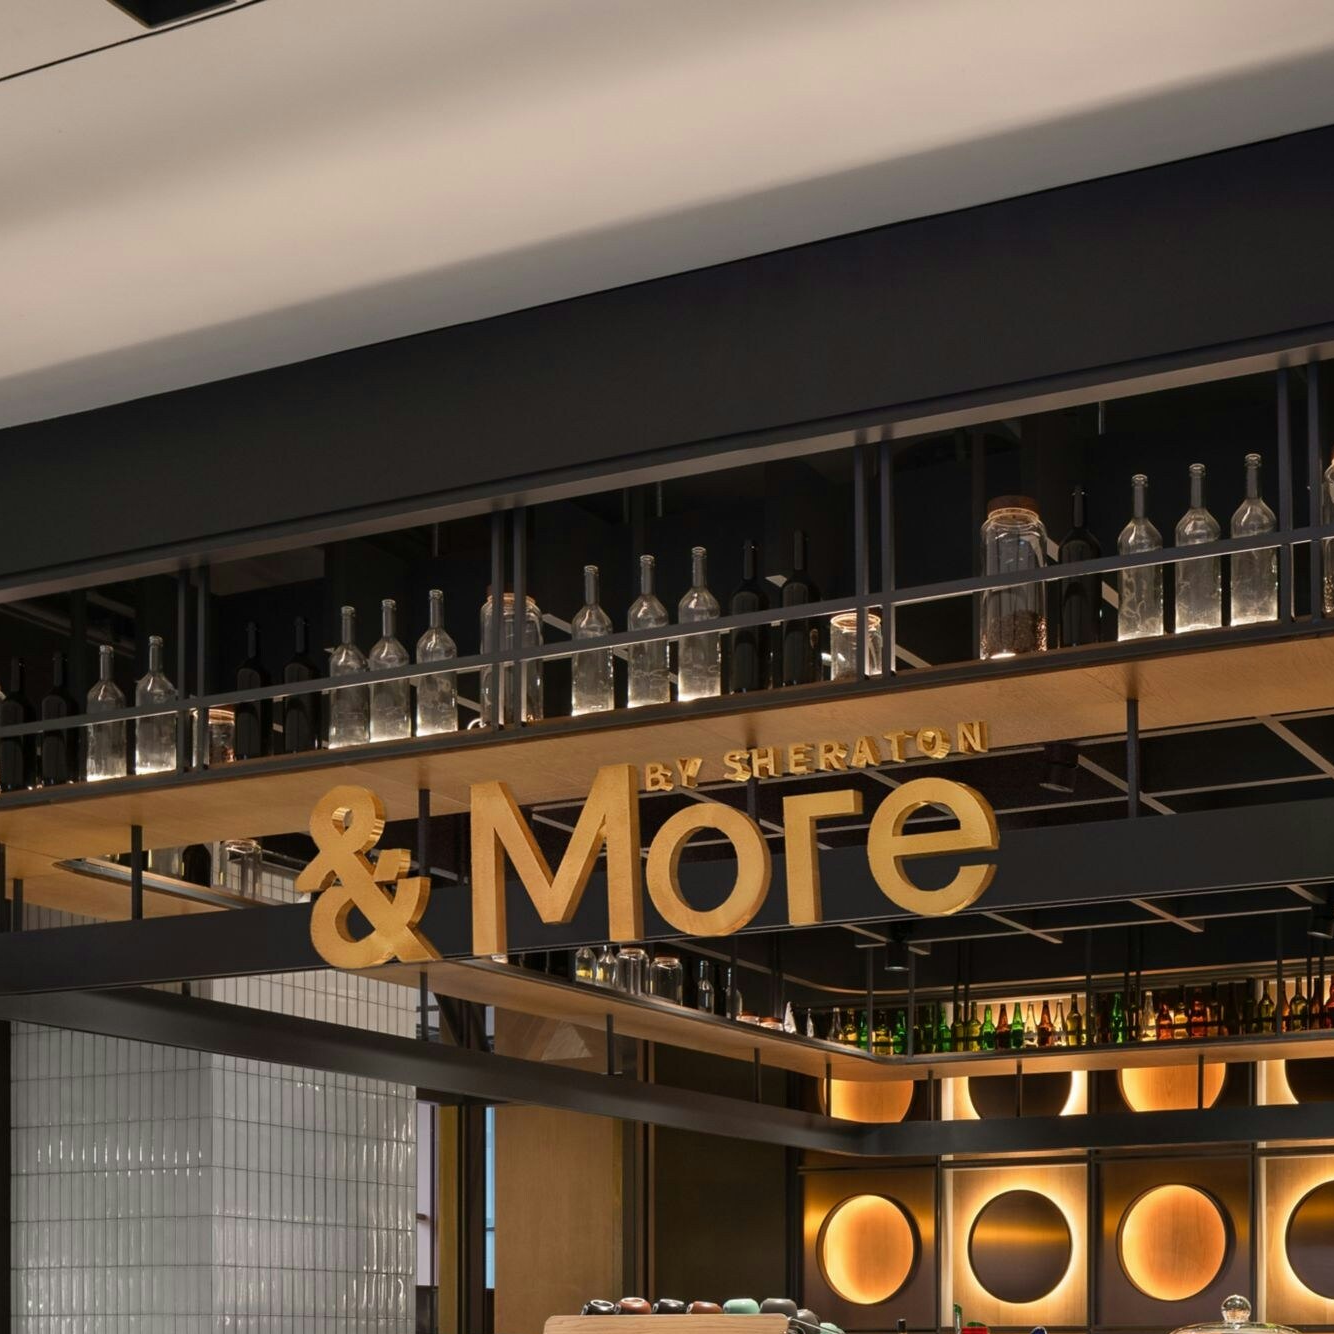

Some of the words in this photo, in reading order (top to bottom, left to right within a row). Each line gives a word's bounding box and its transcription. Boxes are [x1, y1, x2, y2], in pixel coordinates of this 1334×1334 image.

[645, 757, 703, 792] BY
[723, 720, 989, 782] SHERATON
[295, 784, 442, 969] &
[470, 762, 1000, 957] More
